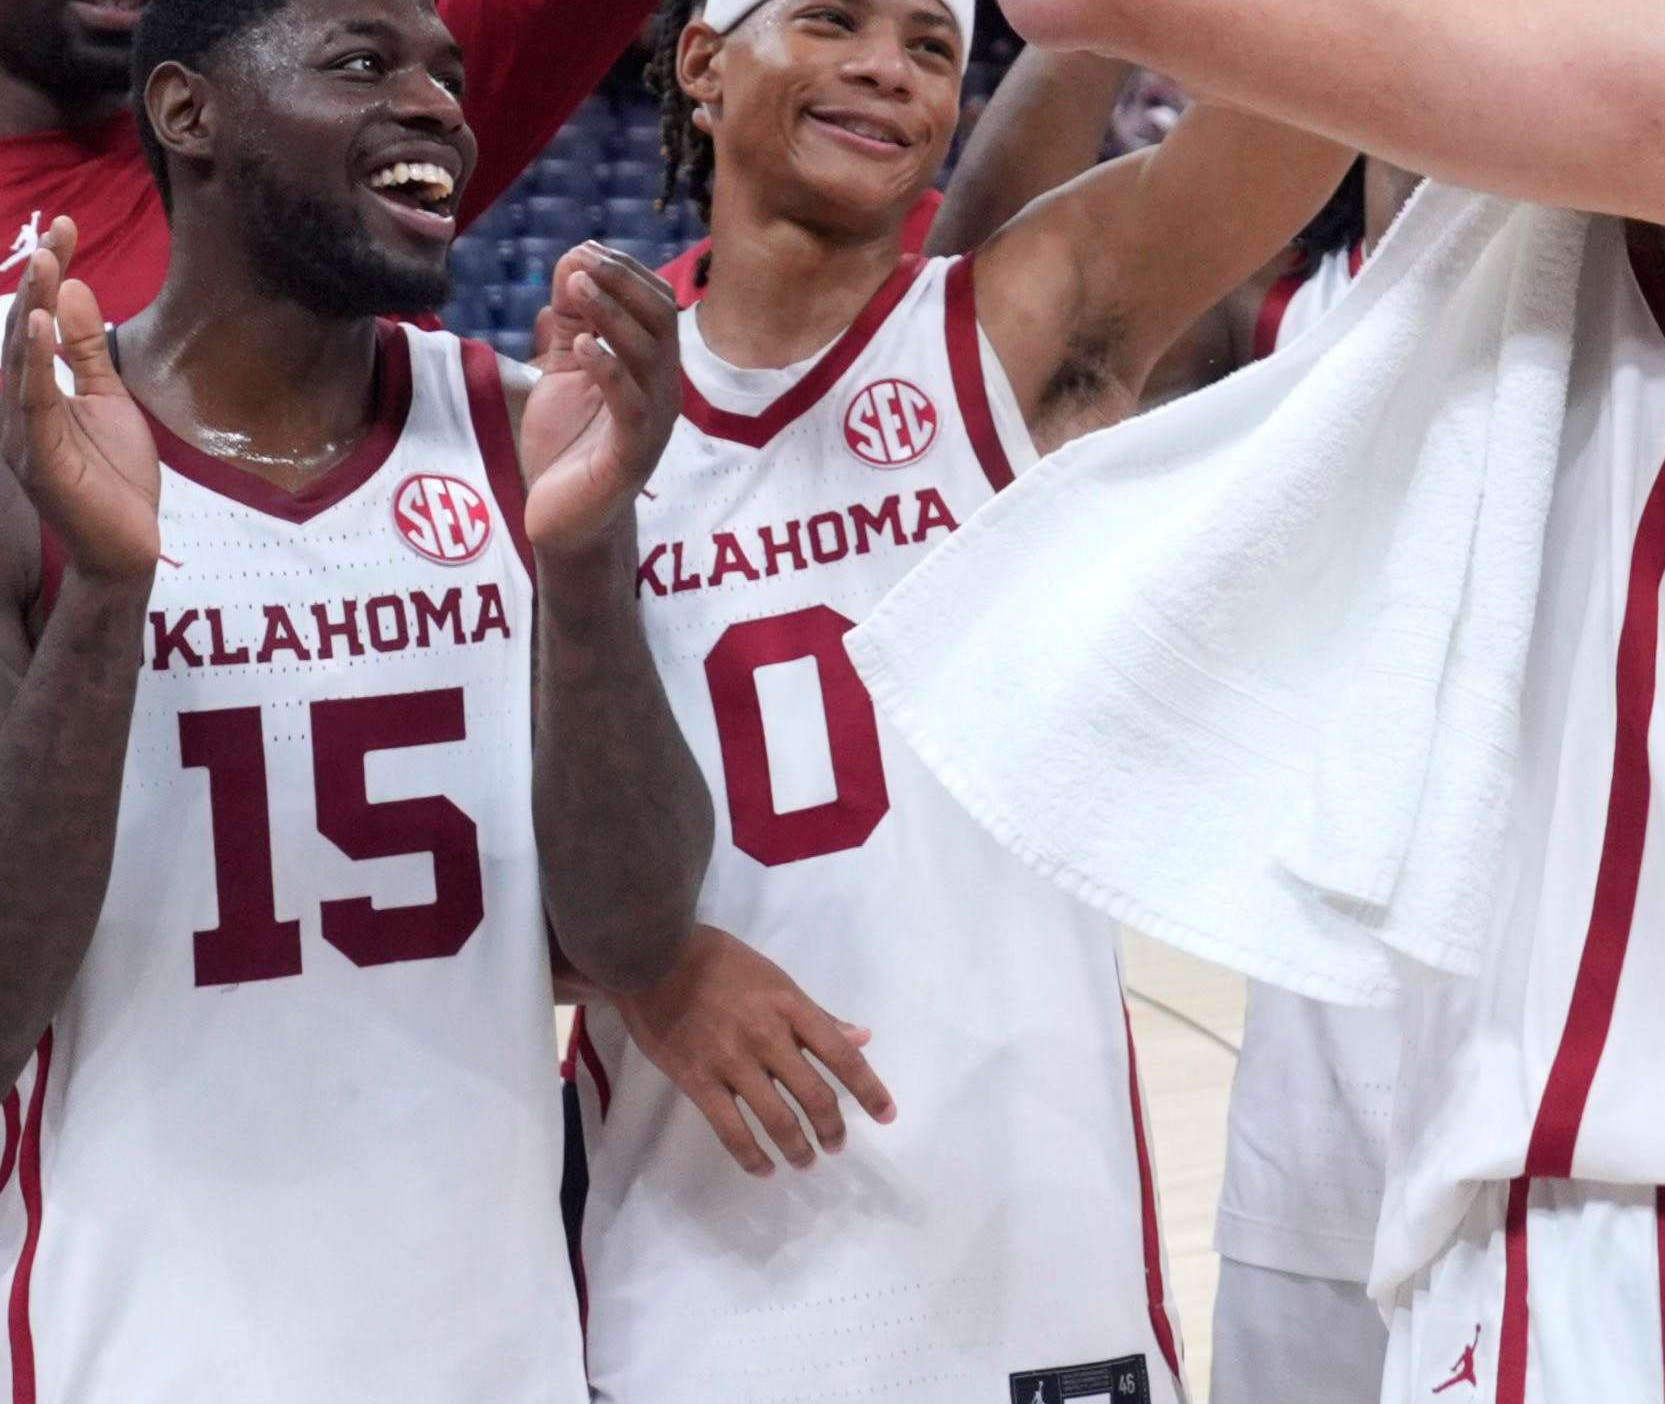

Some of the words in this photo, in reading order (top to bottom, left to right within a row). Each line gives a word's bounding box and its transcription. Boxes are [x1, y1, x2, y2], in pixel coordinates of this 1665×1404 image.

[846, 381, 937, 465] SEC
[399, 481, 489, 563] SEC
[636, 487, 961, 600] KLAHOMA
[139, 583, 511, 672] KLAHOMA
[177, 686, 486, 988] 15
[1118, 1372, 1136, 1396] 46
